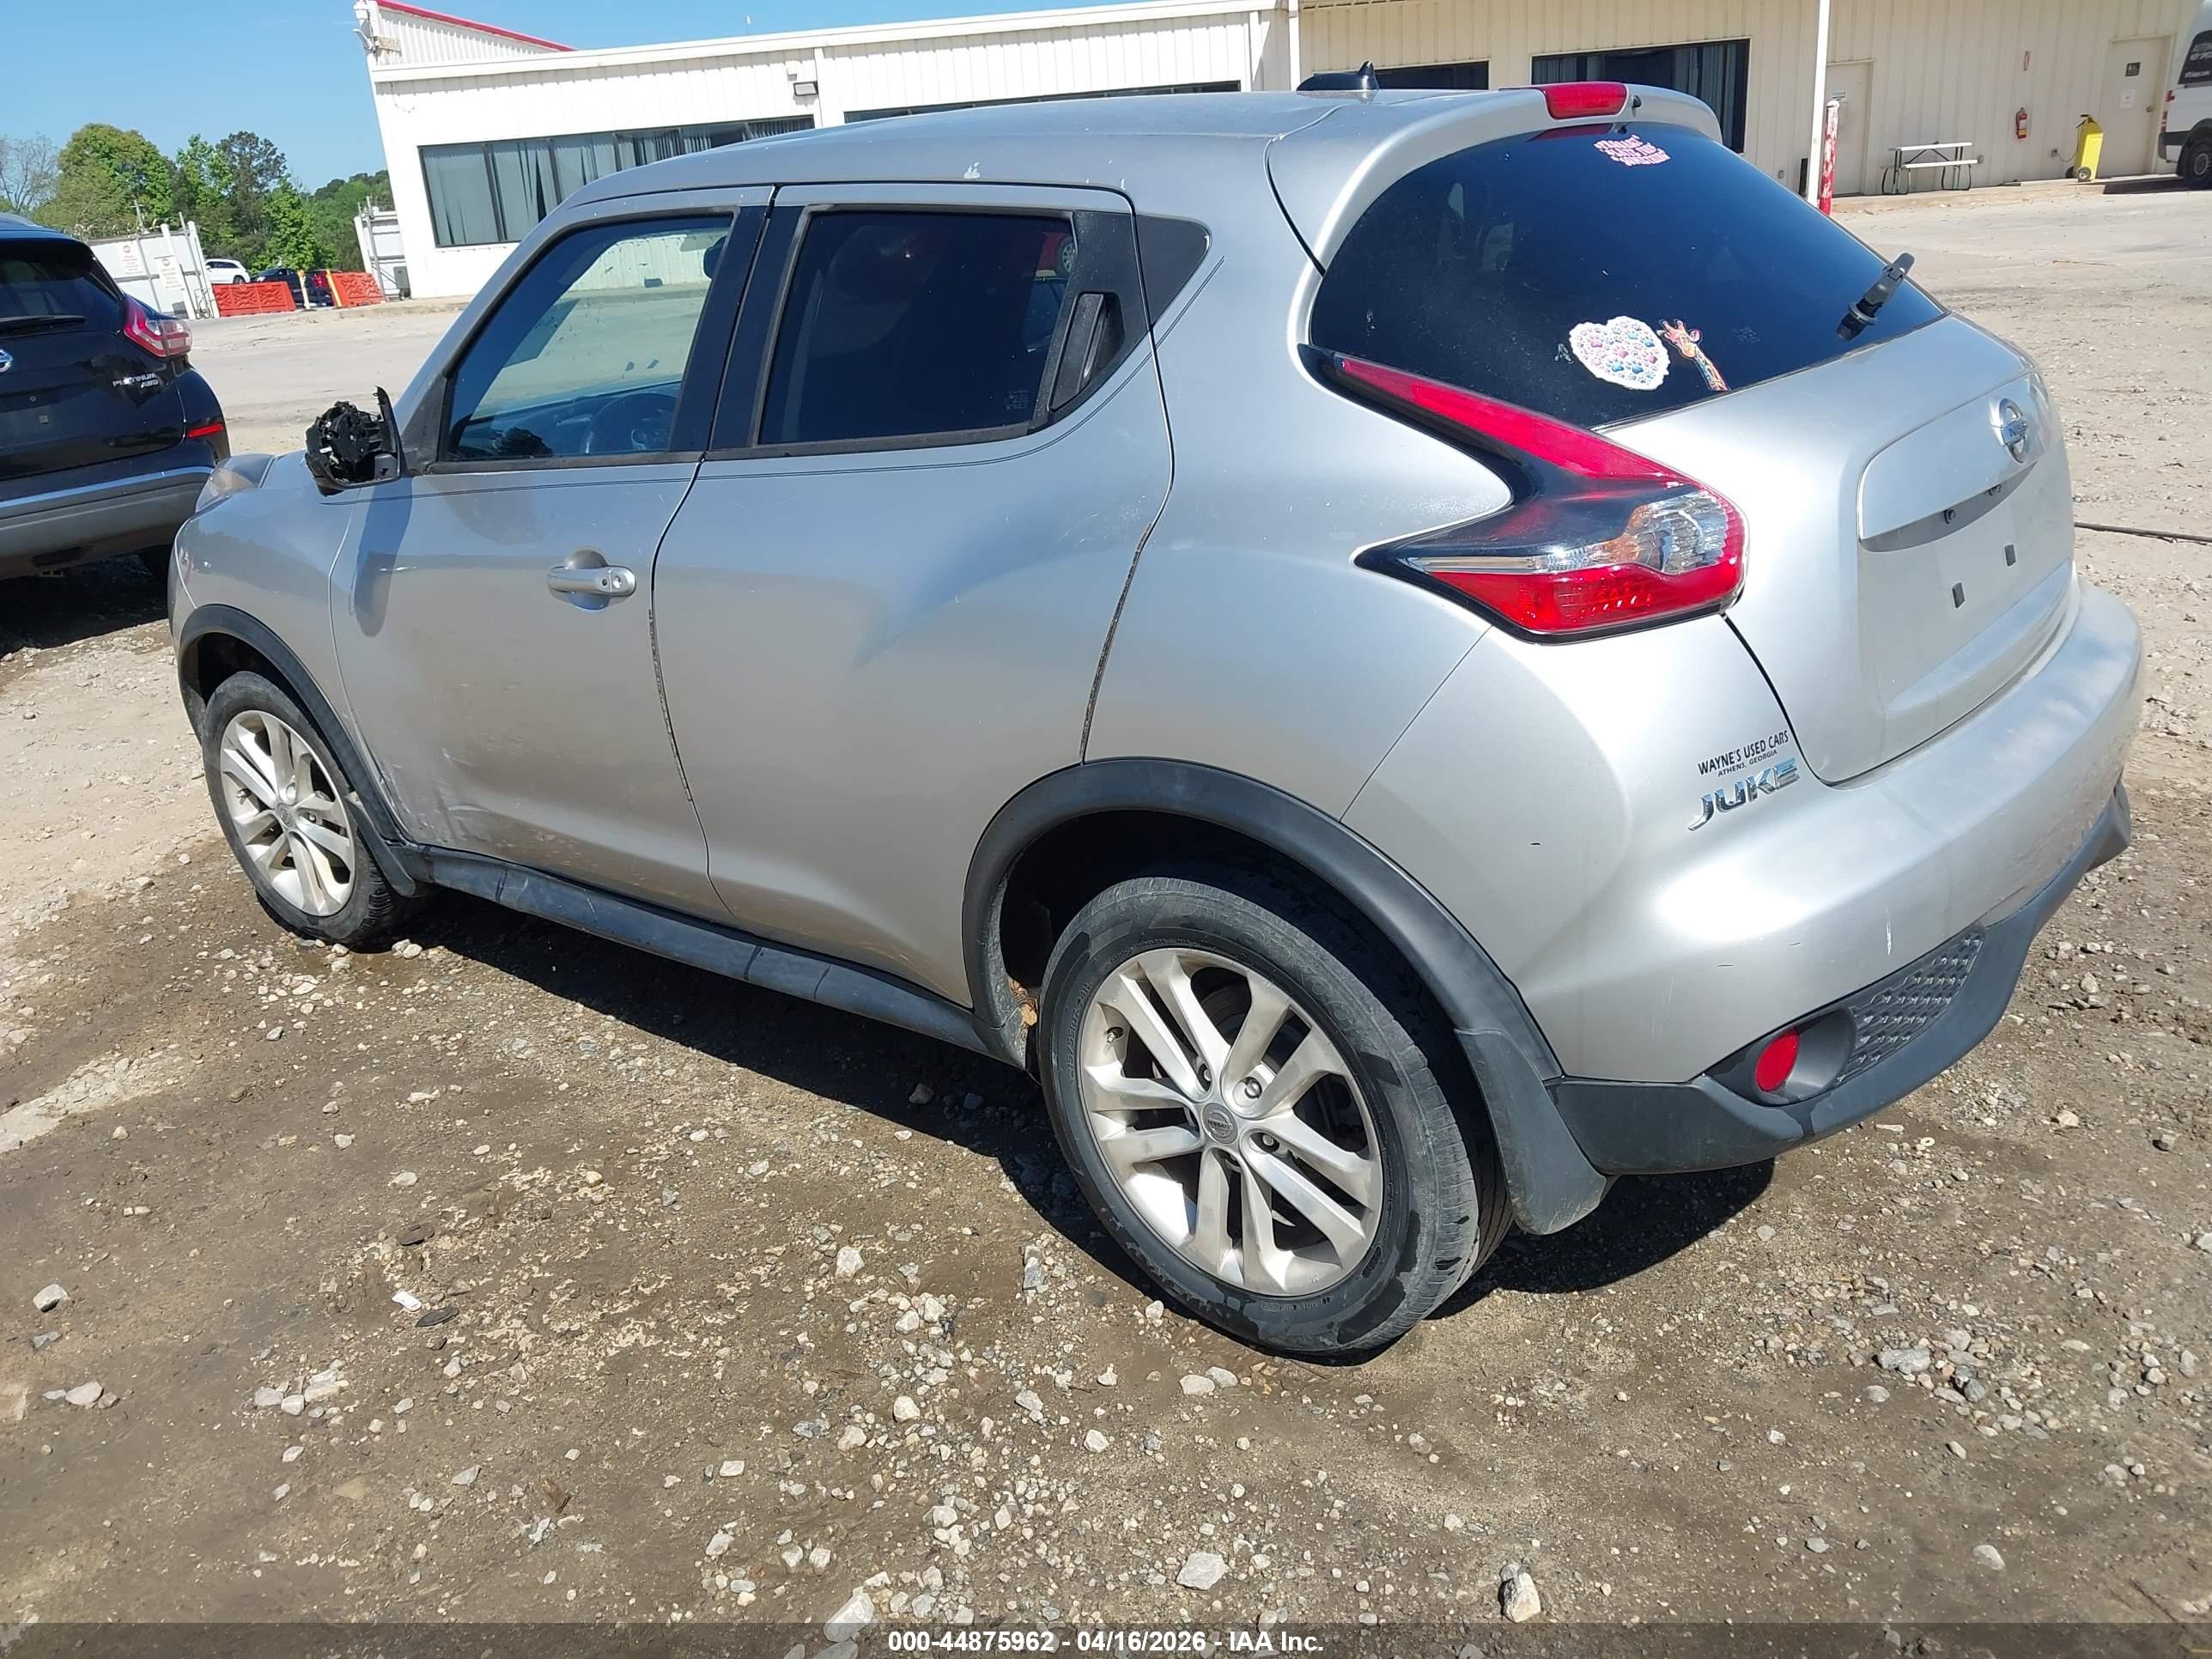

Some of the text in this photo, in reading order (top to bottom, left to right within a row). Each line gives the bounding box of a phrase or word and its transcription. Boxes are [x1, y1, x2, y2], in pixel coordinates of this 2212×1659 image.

[1698, 729, 1789, 775] WAYNE'S USED CARS
[1748, 749, 1778, 765] GEORGIA
[1687, 756, 1800, 831] JUKE
